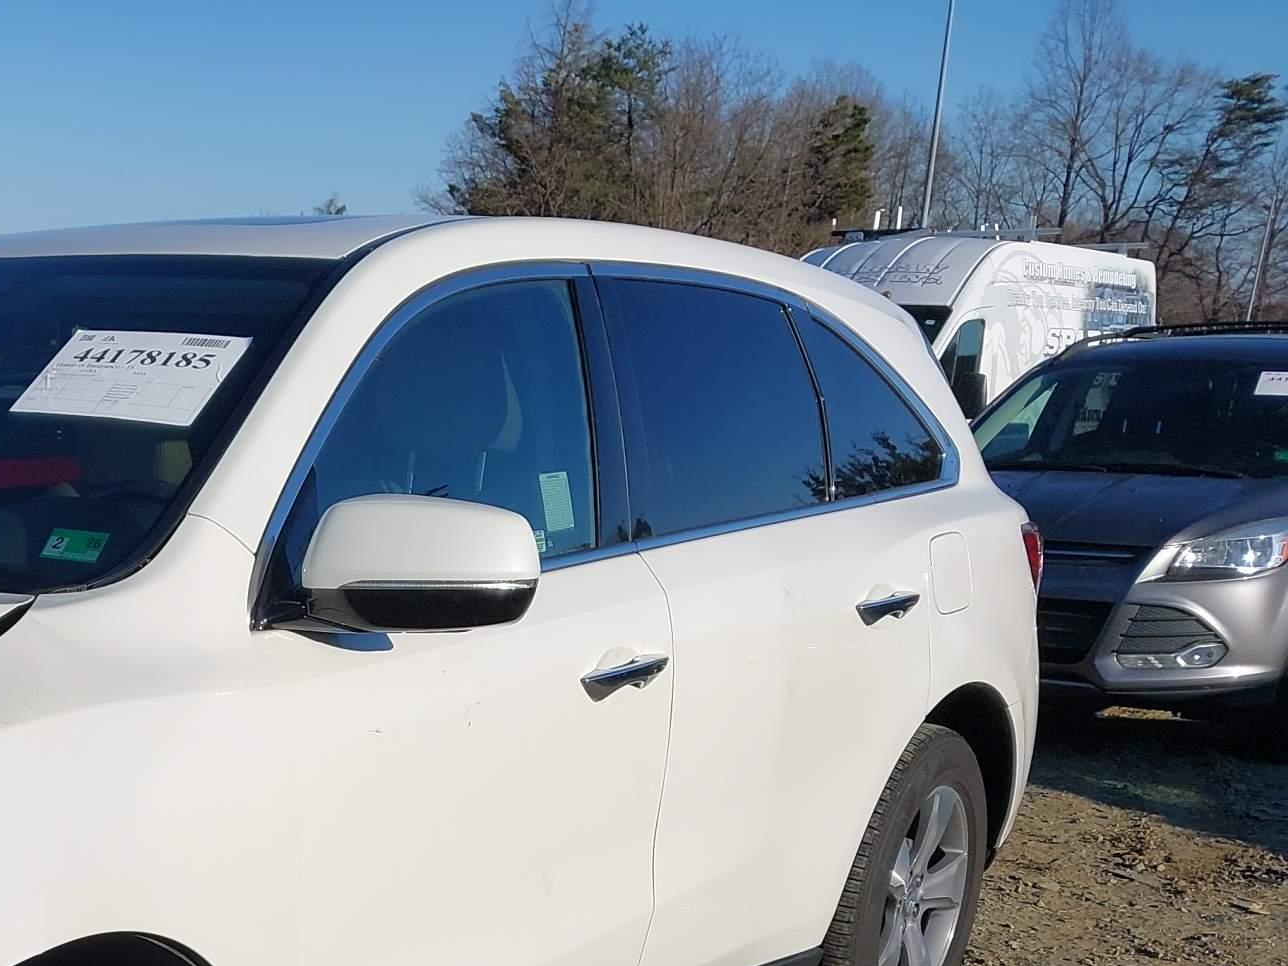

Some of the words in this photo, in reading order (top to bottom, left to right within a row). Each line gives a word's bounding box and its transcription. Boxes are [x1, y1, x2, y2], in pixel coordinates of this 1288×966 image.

[1023, 257, 1056, 279] Custom
[1092, 267, 1137, 289] Remodeling
[73, 347, 216, 370] 44178185
[52, 536, 65, 549] 2
